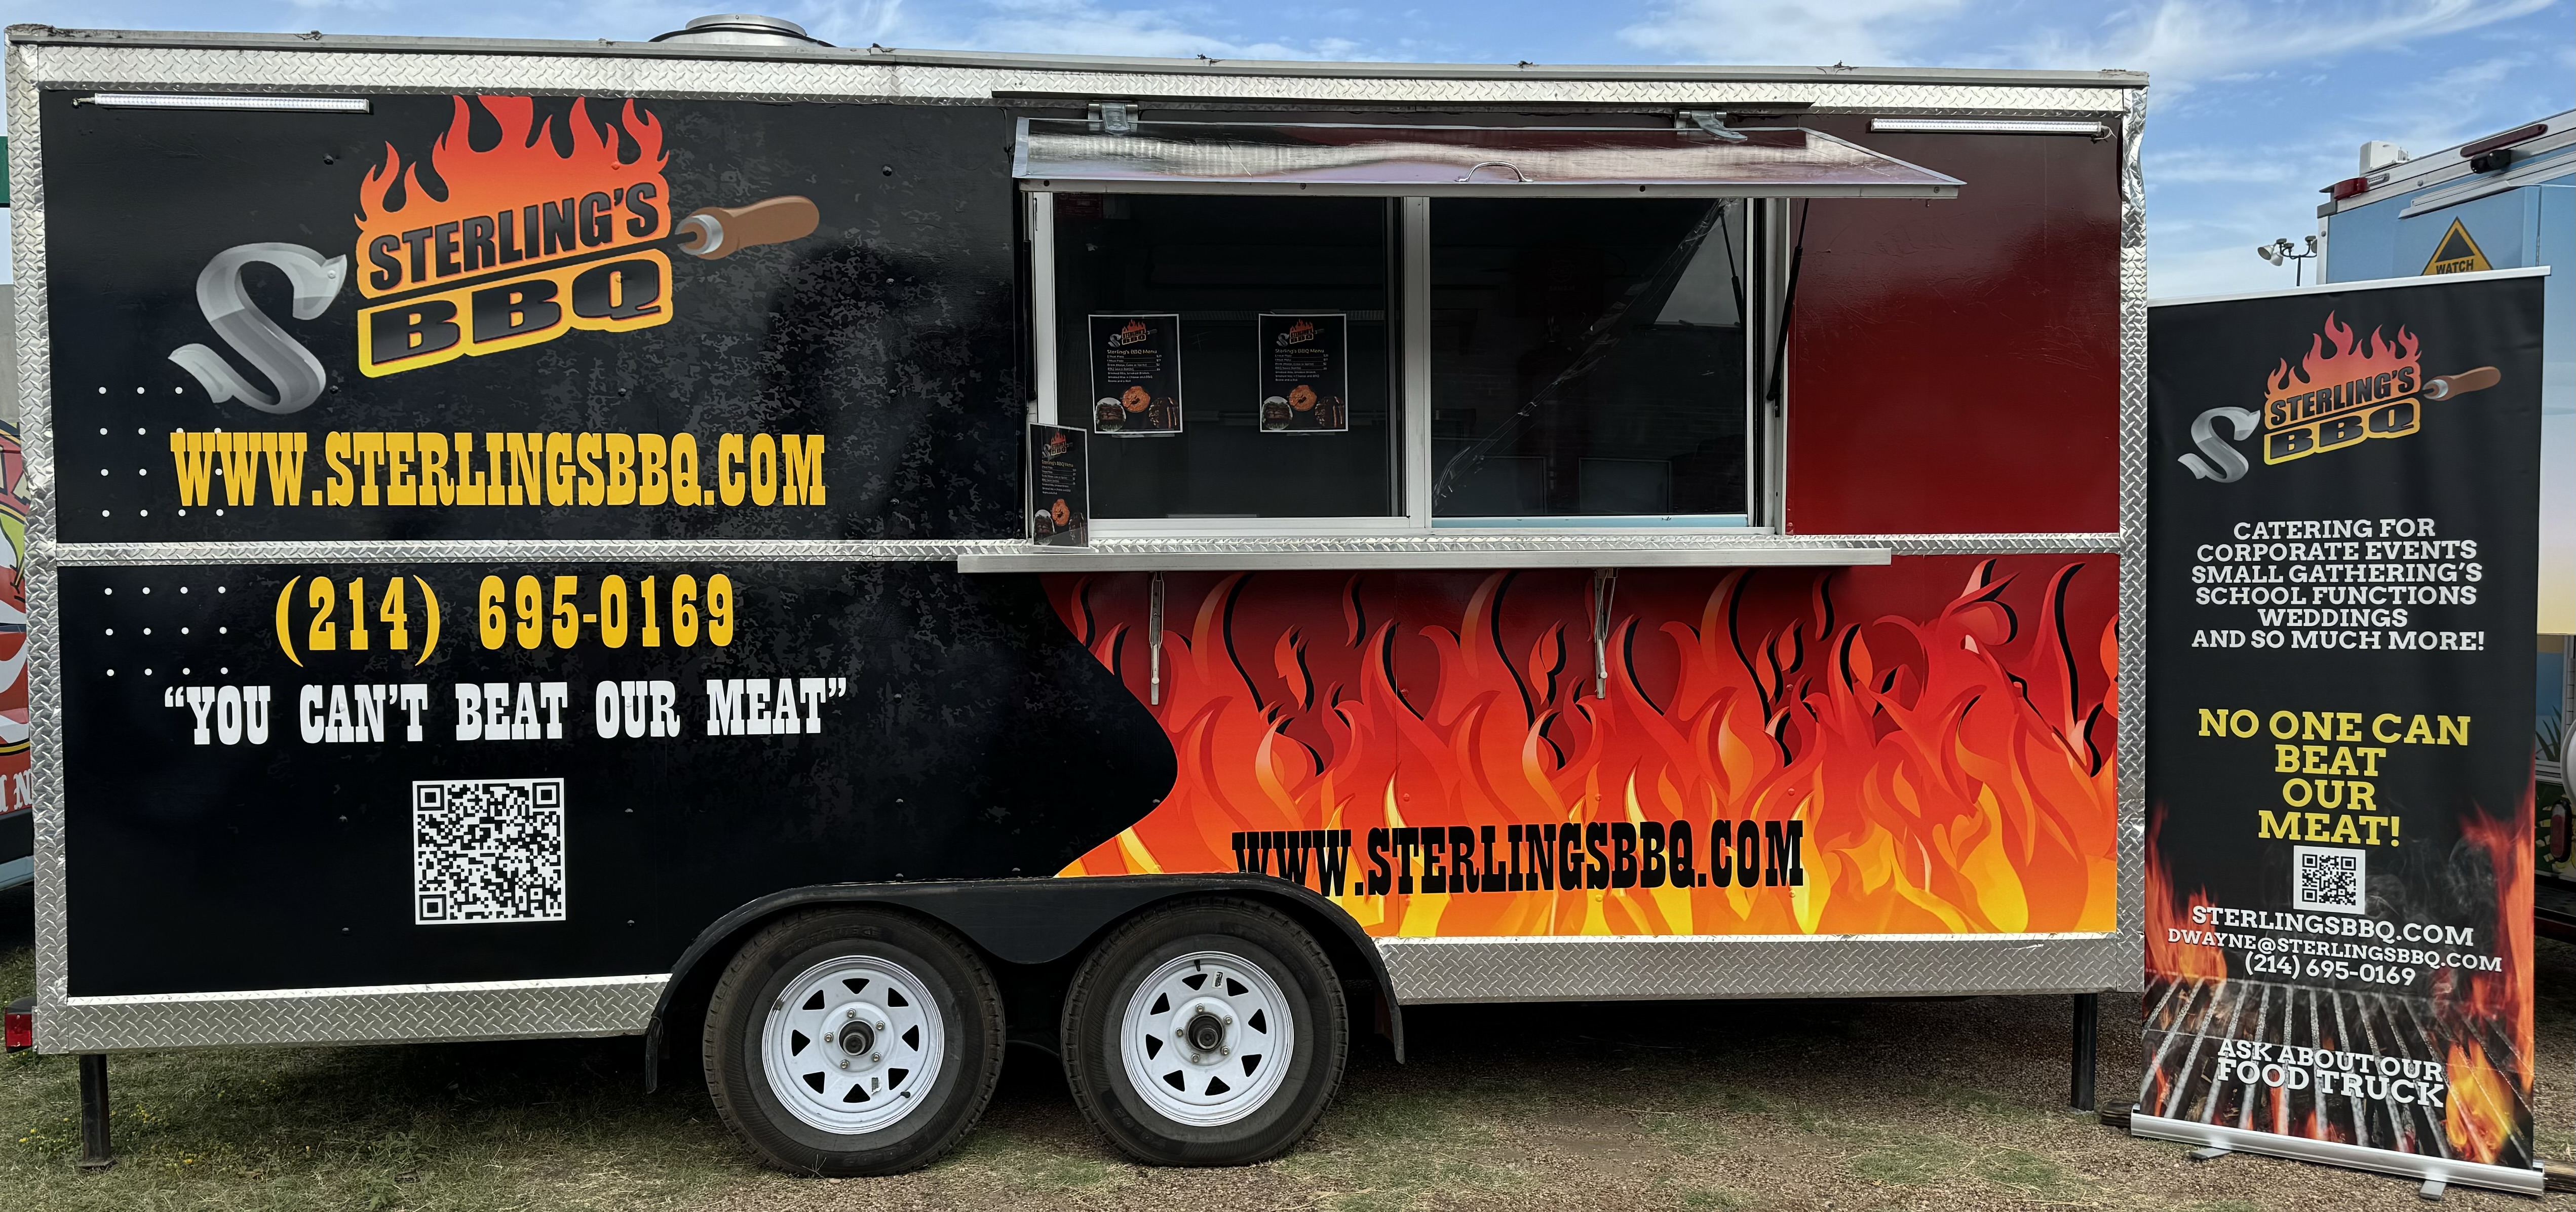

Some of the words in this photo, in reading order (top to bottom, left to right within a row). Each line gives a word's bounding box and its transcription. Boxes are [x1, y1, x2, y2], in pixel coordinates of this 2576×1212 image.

[366, 181, 660, 291] STERLING'S
[2436, 259, 2474, 275] WATCH
[369, 258, 662, 366] BBQ
[2270, 366, 2414, 426] STERLING'S
[2270, 402, 2414, 459] BBQ
[170, 432, 826, 506] WWW.STERLINGSBBQ.COM
[2234, 520, 2372, 540] CATERING
[2380, 518, 2435, 537] FOR
[2198, 542, 2359, 562] CORPORATE
[2366, 540, 2477, 559] EVENTS
[2192, 565, 2283, 583] SMALL
[2289, 562, 2482, 582] GATHERING'S
[2196, 587, 2306, 604] SCHOOL
[2313, 586, 2476, 604] FUNCTIONS
[276, 576, 440, 667] (214)
[480, 574, 733, 650] 695-0169
[2258, 609, 2407, 627] WEDDINGS
[2192, 630, 2245, 647] AND
[2251, 630, 2284, 648] SO
[2291, 631, 2381, 649] MUCH
[2389, 631, 2484, 650] MORE!
[165, 686, 271, 745] “YOU
[300, 684, 428, 743] CAN’T
[455, 682, 568, 740] BEAT
[596, 681, 680, 738] OUR
[707, 677, 846, 735] MEAT”
[2200, 709, 2259, 738] NO
[2269, 711, 2361, 741] ONE
[2372, 714, 2470, 746] CAN
[2276, 745, 2386, 776] BEAT
[2283, 779, 2375, 810] OUR
[2259, 811, 2399, 846] MEAT!
[1231, 819, 1804, 897] WWW.STERLINGSBBQ.COM
[2192, 905, 2474, 946] STERLINGSBBQ.COM
[2168, 928, 2502, 972] DWAYNE@STERLINGSBBQ.COM
[2245, 951, 2300, 980] (214)
[2305, 958, 2416, 987] 695-0169
[2218, 1039, 2273, 1062] ASK
[2277, 1046, 2374, 1074] ABOUT
[2381, 1056, 2444, 1082] OUR
[2218, 1057, 2310, 1090] FOOD
[2316, 1070, 2445, 1108] TRUCK
